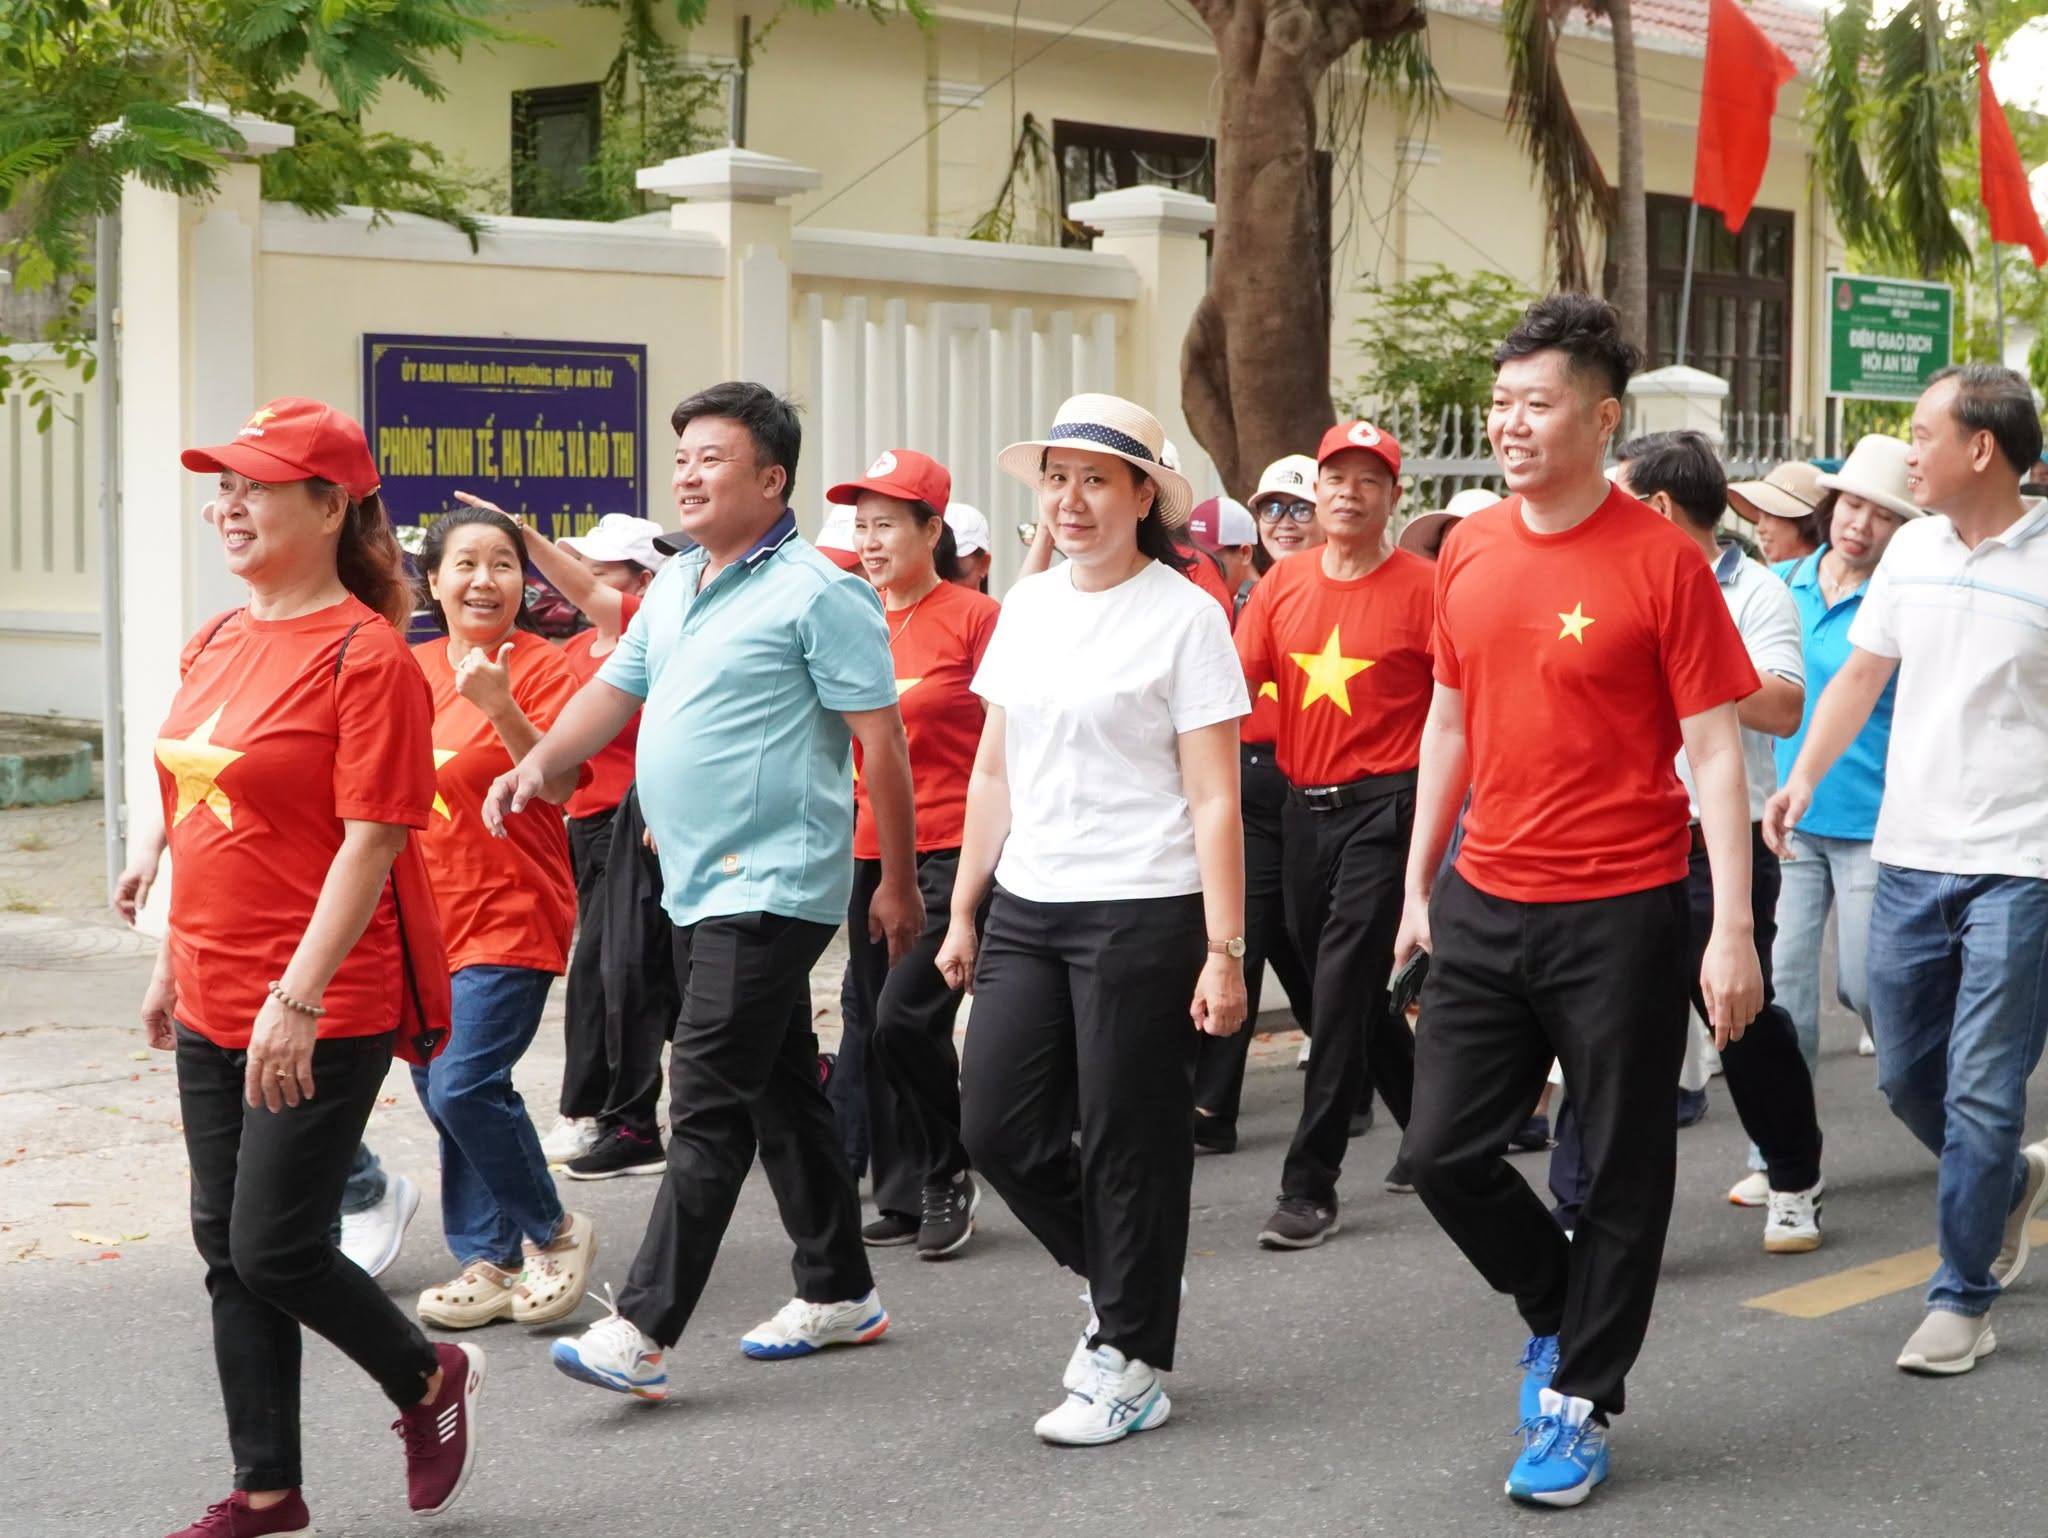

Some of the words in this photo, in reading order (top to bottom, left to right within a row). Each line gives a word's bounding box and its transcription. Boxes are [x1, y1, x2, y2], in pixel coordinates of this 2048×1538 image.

[1876, 331, 1905, 351] GIAO
[401, 356, 417, 382] ỦY
[419, 363, 445, 383] BAN
[446, 360, 479, 384] NHÂN
[480, 359, 505, 385] DÂN
[507, 361, 553, 387] PHƯỜNG
[554, 365, 573, 391] HỘI
[575, 370, 592, 388] AN
[593, 365, 614, 389] TÂY
[1883, 355, 1899, 371] AN
[379, 413, 433, 476] PHÒNG
[435, 428, 473, 476] KINH
[475, 412, 499, 482] TẾ,
[502, 432, 523, 488] HẠ
[525, 412, 565, 477] TẦNG
[566, 421, 587, 478] VÀ
[588, 422, 610, 478] ĐÔ
[611, 431, 635, 488] THỊ
